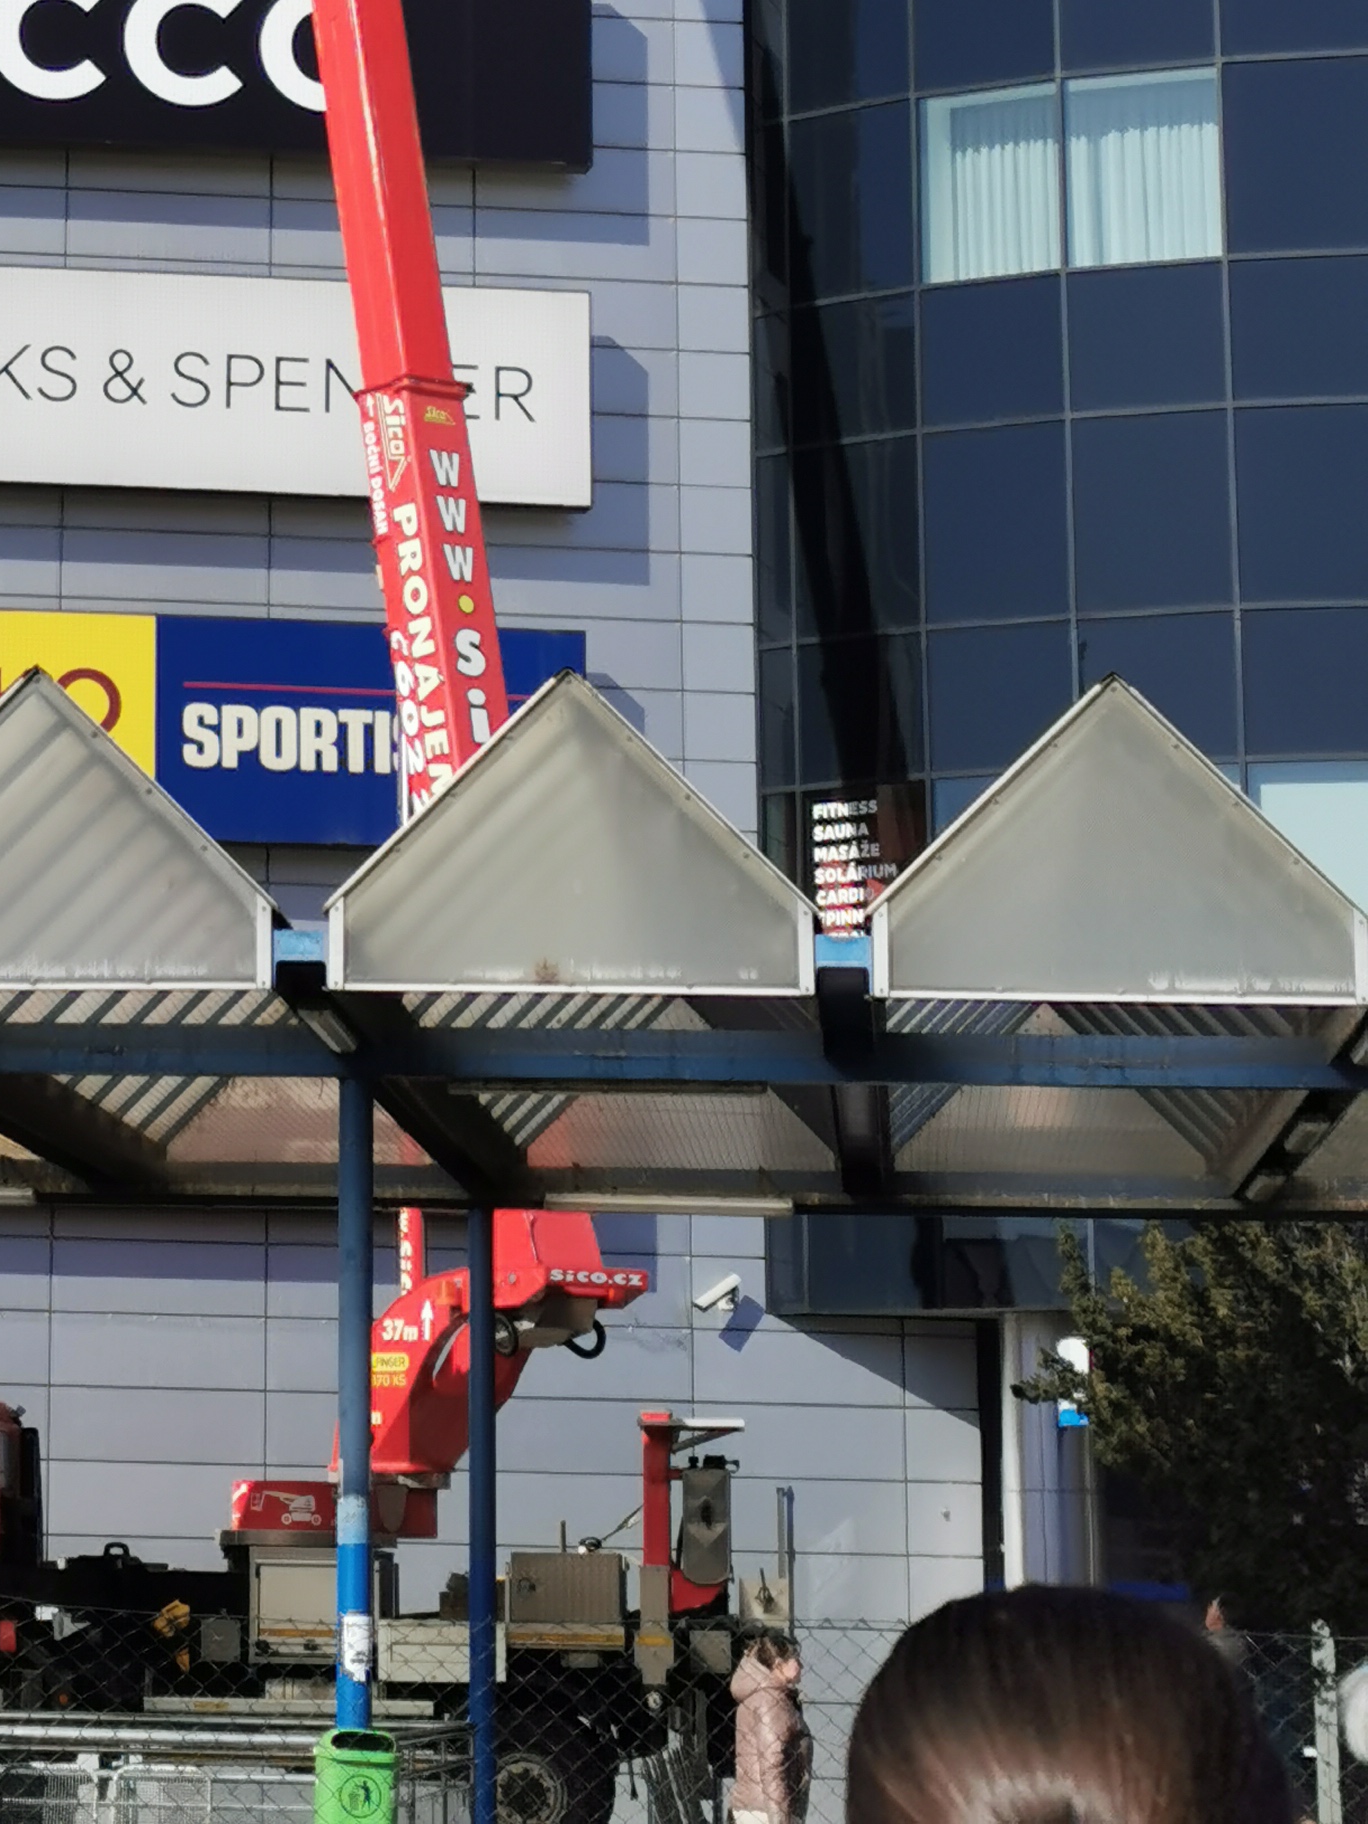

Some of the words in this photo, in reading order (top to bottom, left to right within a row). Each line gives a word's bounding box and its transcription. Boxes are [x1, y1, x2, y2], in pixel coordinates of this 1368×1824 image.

[102, 349, 148, 407] &
[171, 350, 536, 424] SPENR
[363, 422, 384, 475] BOČNÍ
[370, 475, 389, 536] DOSAH
[183, 702, 398, 775] SPORTI
[813, 800, 878, 819] FITNESS
[813, 823, 870, 842] SAUNA
[814, 840, 881, 863] MASÁŽE
[814, 862, 898, 885] SOLÁRIUM
[382, 1319, 419, 1342] 37m
[373, 1356, 406, 1368] FINGER
